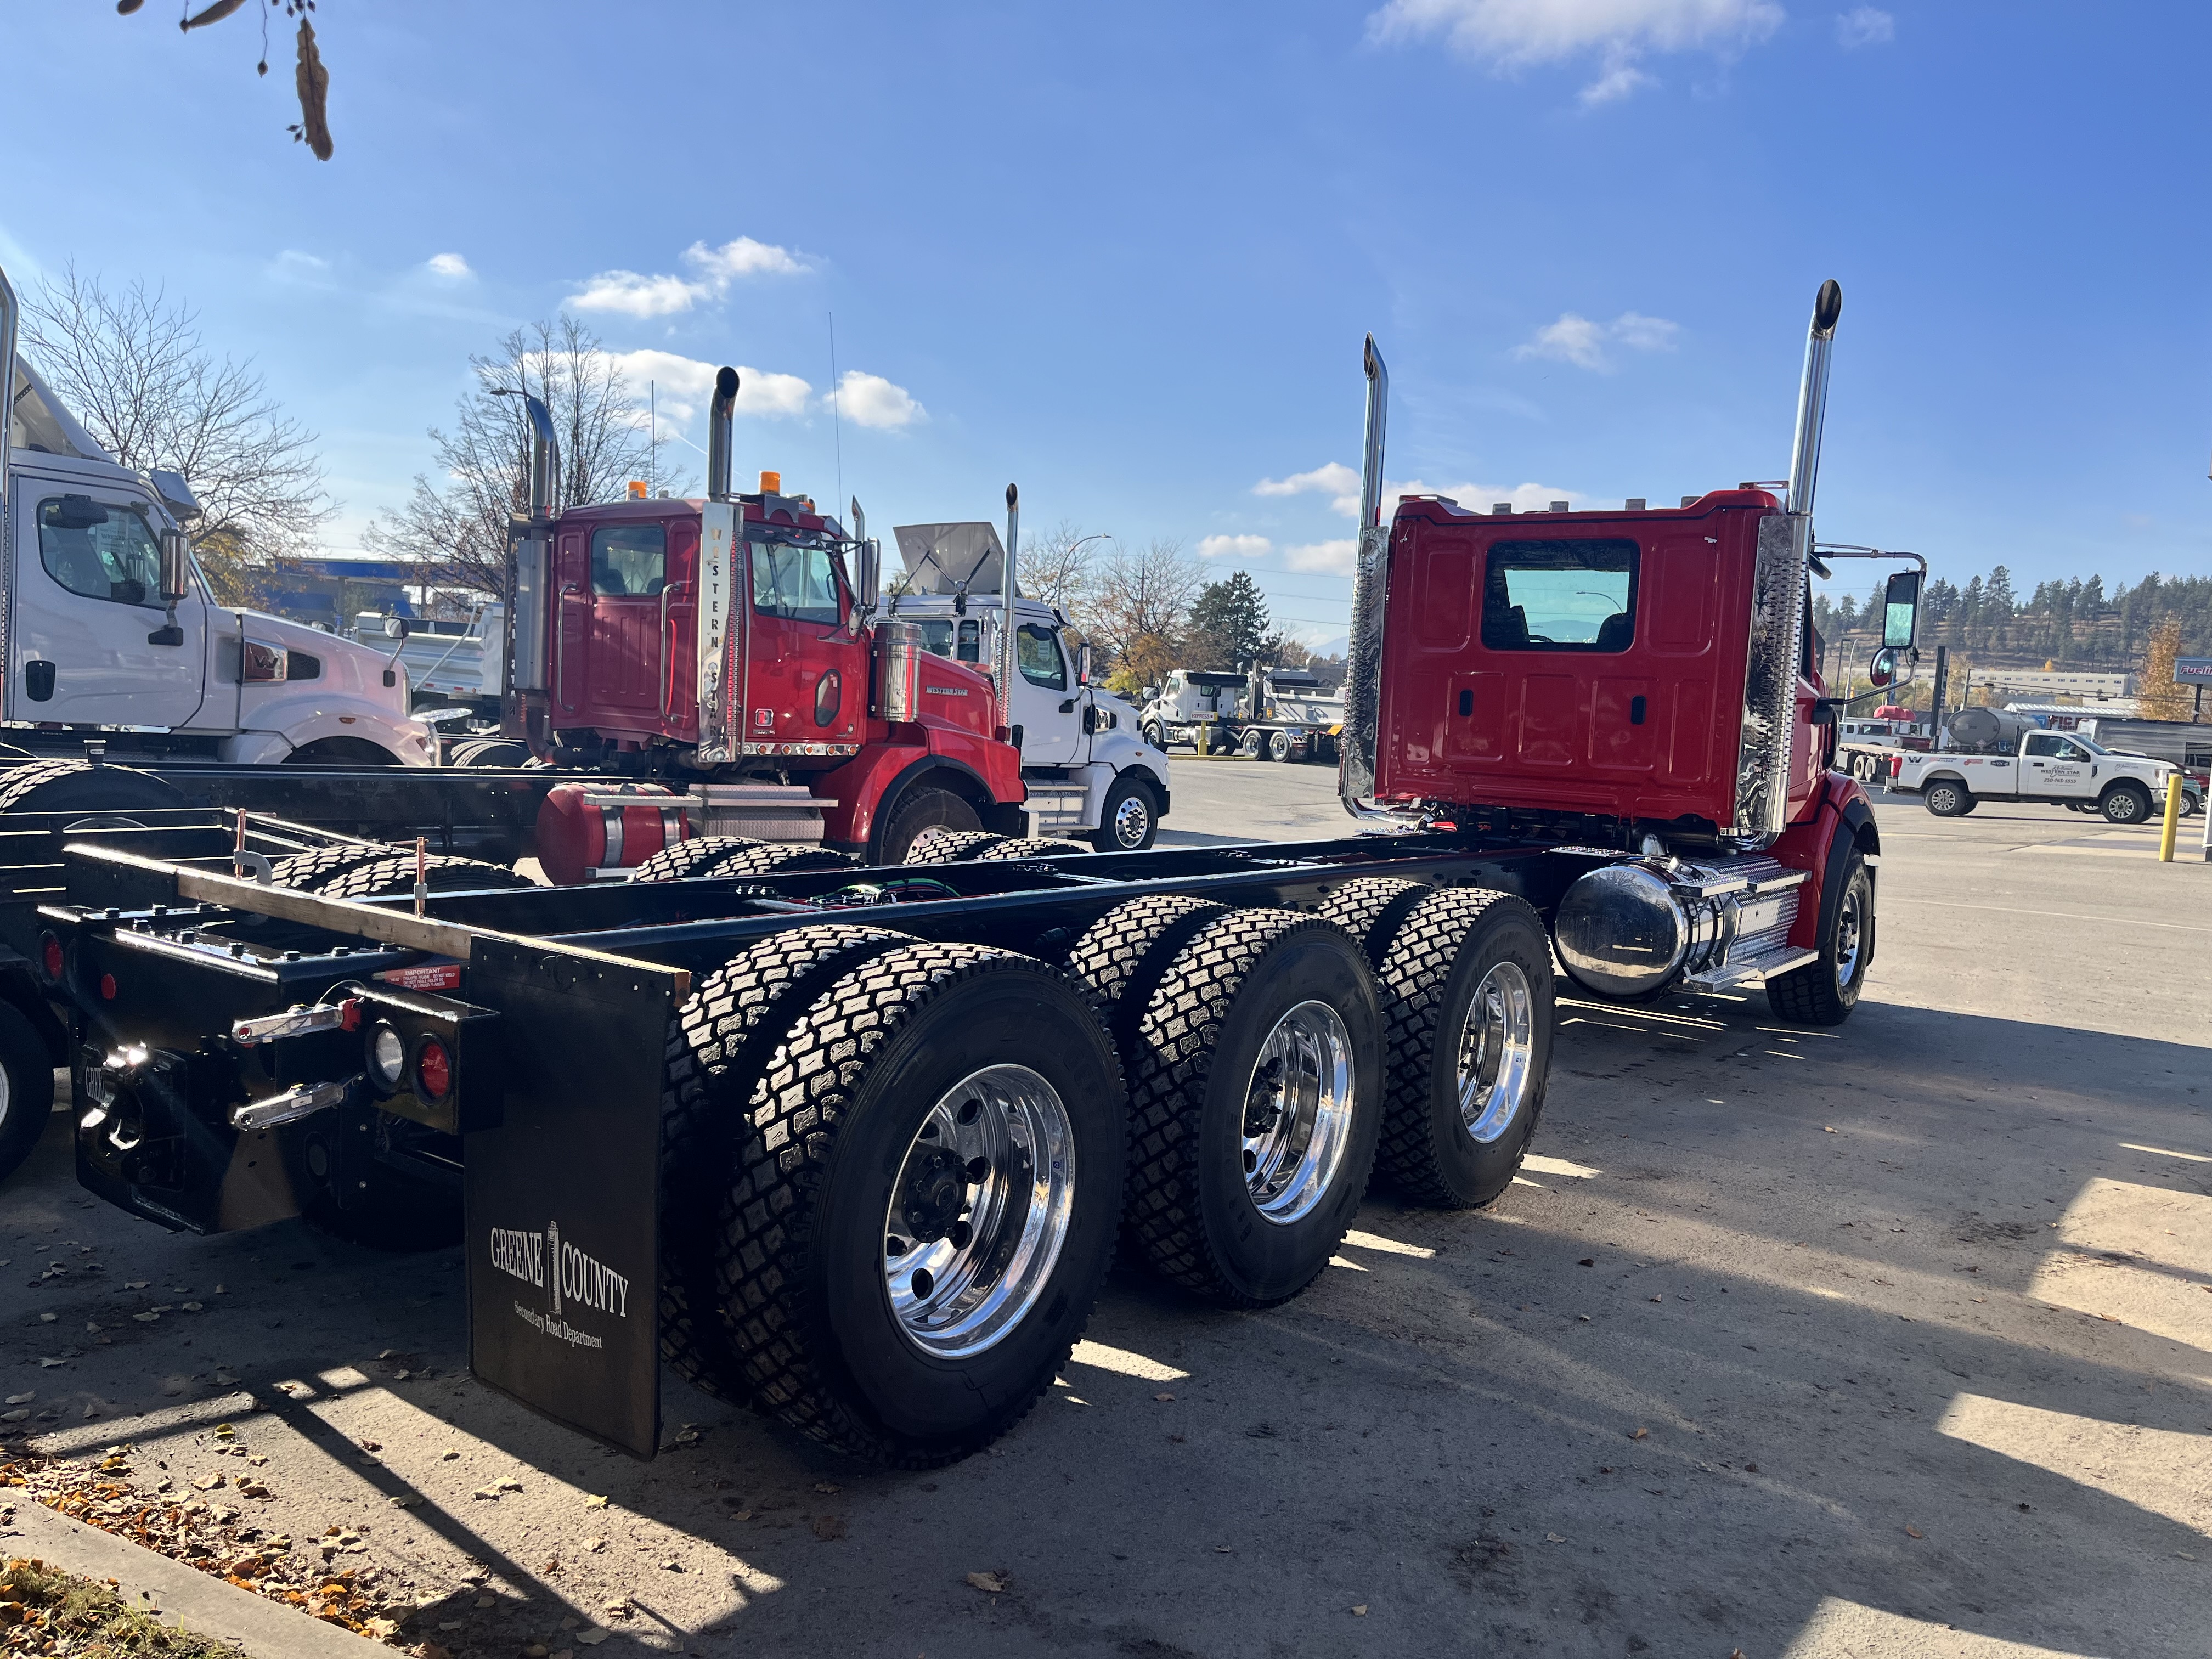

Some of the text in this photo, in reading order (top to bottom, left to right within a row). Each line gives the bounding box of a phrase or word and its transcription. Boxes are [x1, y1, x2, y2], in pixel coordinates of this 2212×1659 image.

[710, 528, 722, 647] WESTERN
[926, 685, 968, 696] WESTERN STAR
[405, 968, 441, 976] IMPORTANT
[86, 1066, 105, 1104] GREE
[491, 1227, 629, 1317] GREENE COUNTY
[515, 1300, 602, 1348] Secondary Road Department
